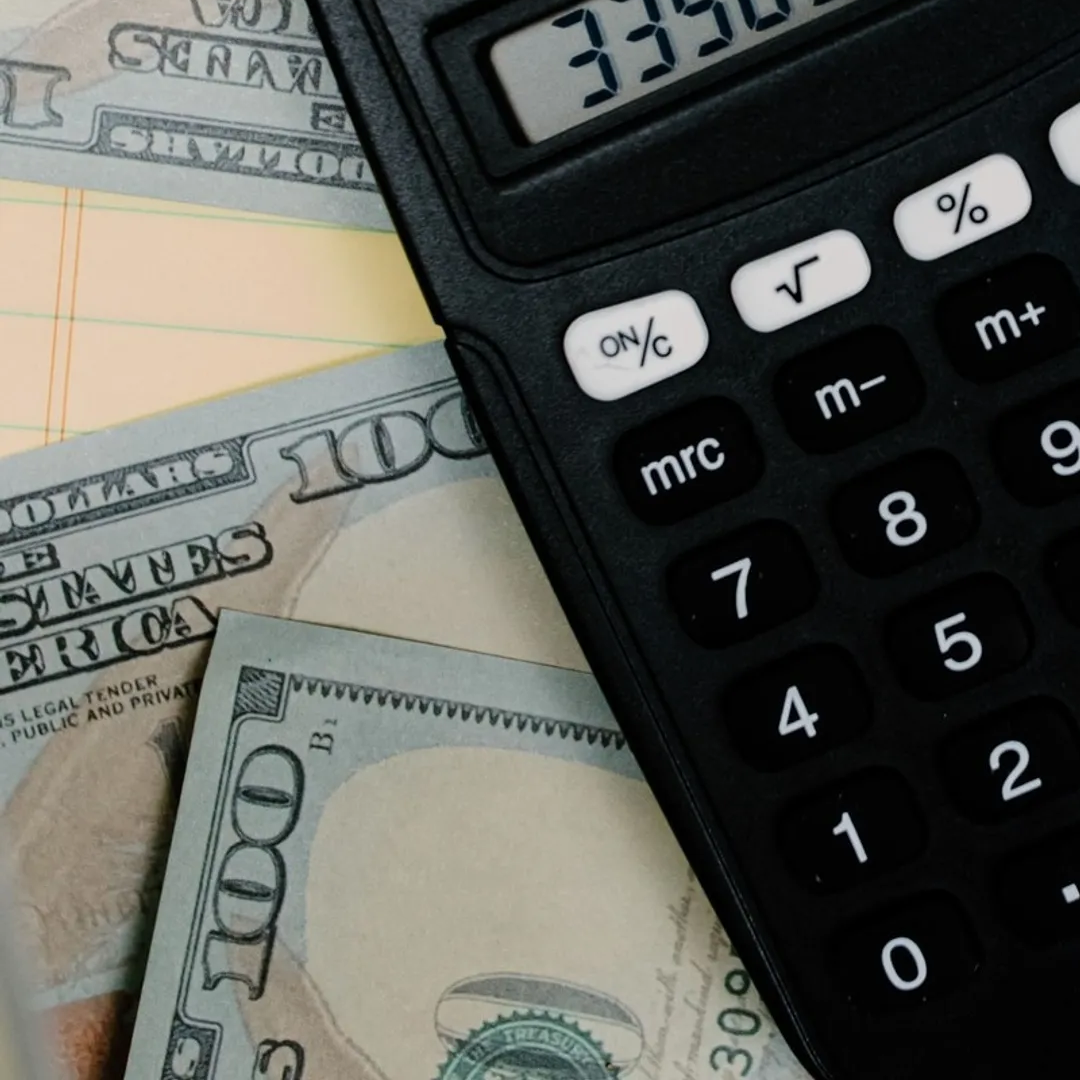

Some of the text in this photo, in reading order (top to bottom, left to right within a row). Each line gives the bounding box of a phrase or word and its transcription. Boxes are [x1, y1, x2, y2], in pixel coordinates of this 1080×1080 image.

[642, 438, 724, 495] mrc
[879, 492, 926, 545] 8
[712, 558, 754, 618] 7
[935, 613, 982, 672] 5
[11, 712, 79, 743] PUBLIC
[87, 701, 124, 722] AND
[21, 696, 80, 723] LEGAL
[84, 674, 159, 704] TENDER
[779, 686, 818, 738] 4
[990, 741, 1041, 800] 2
[833, 813, 868, 864] 1
[202, 744, 305, 1001] 100
[882, 938, 926, 991] 0
